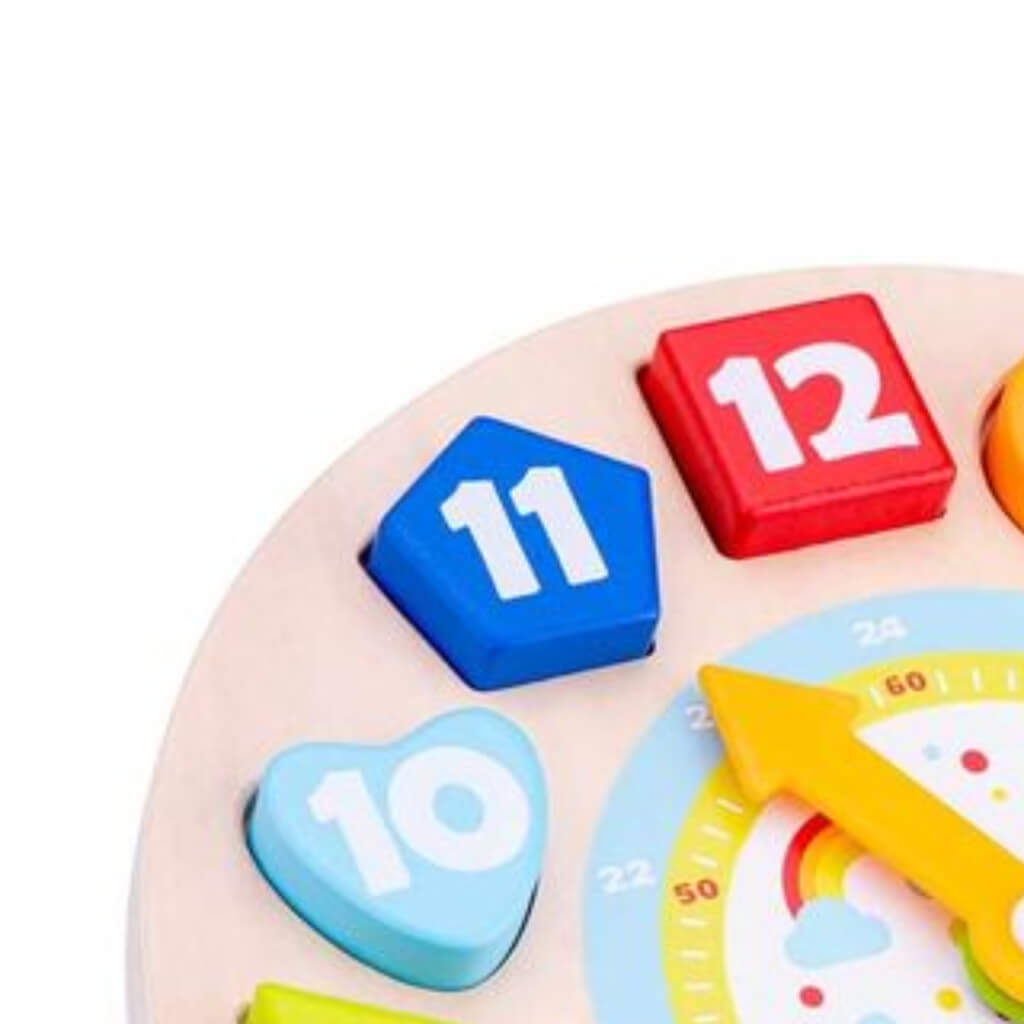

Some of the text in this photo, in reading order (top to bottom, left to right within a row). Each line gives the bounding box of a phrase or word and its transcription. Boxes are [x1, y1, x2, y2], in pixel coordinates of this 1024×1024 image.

[708, 341, 919, 471] 12
[442, 468, 607, 598] 11
[852, 614, 907, 646] 24
[884, 669, 927, 696] 60
[685, 704, 713, 730] 2
[308, 748, 527, 893] 10
[598, 858, 655, 893] 22
[674, 878, 718, 904] 50
